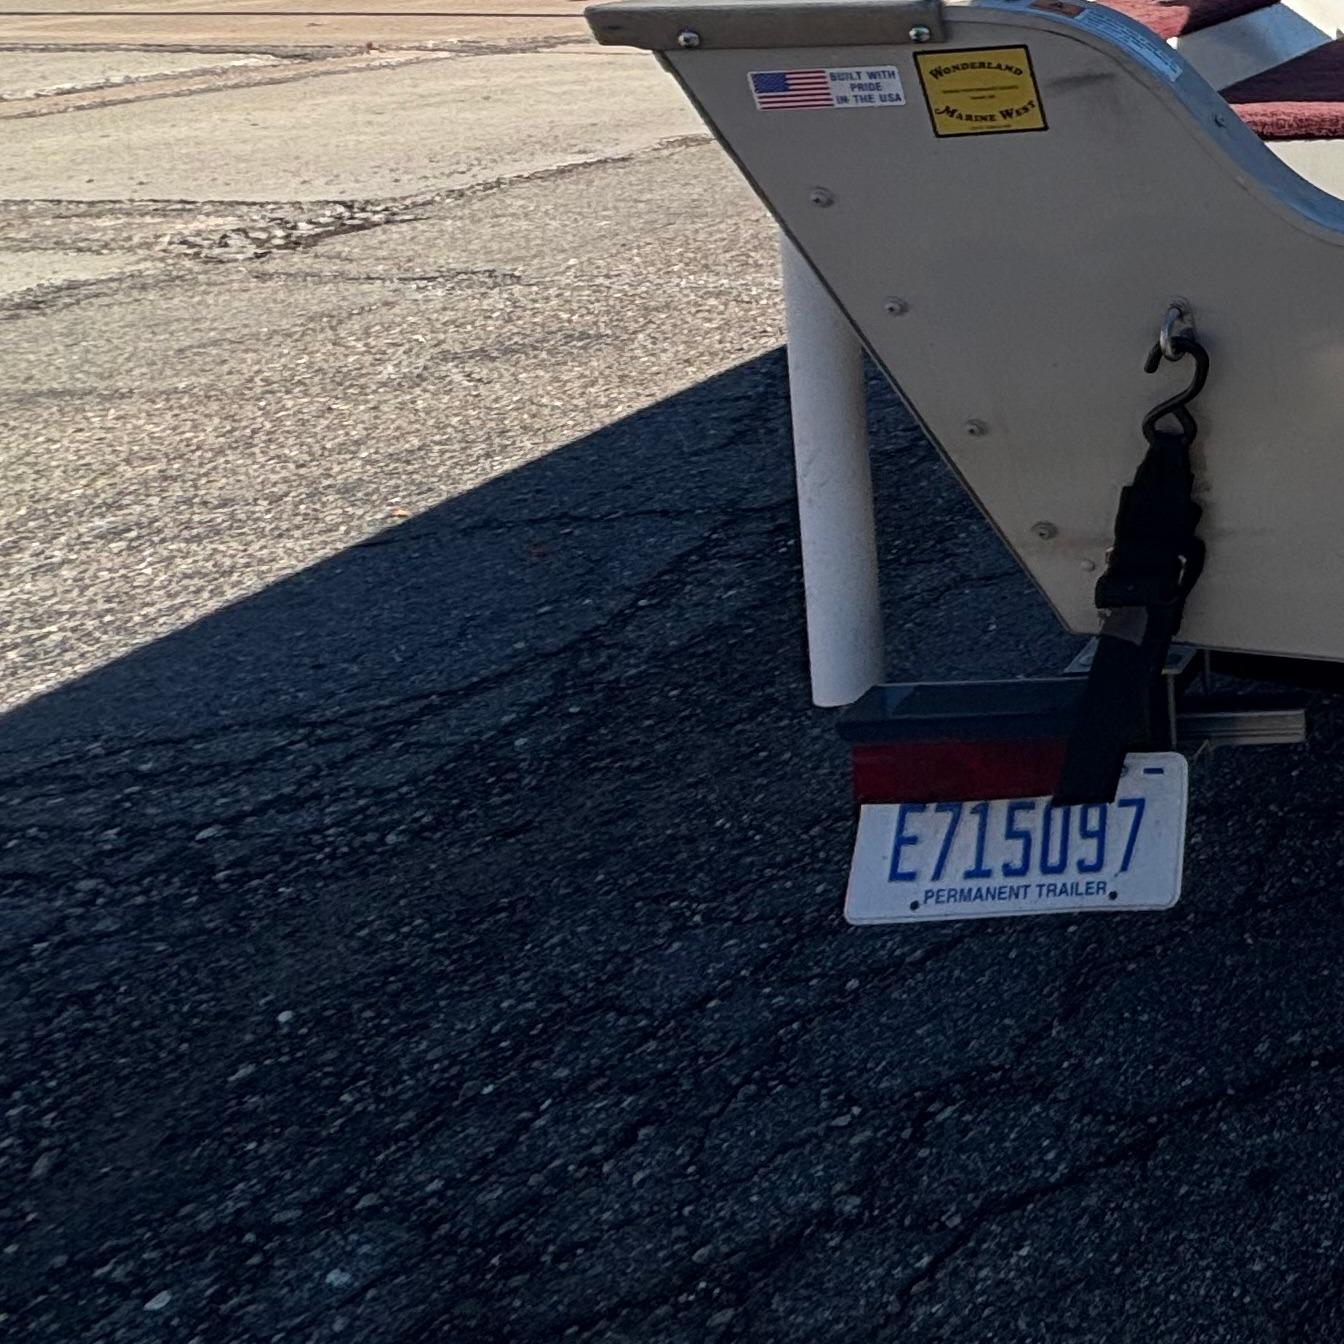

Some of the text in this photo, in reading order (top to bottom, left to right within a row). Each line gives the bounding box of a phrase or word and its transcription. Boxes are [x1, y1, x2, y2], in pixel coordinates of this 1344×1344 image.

[829, 70, 896, 82] BUILT WITH
[928, 61, 1024, 80] WONDERLAND
[850, 82, 883, 92] PRIDE
[835, 93, 902, 104] IN THE USA
[935, 100, 1037, 123] MARINE WEST
[887, 797, 1147, 882] E715097
[923, 881, 1108, 906] PERMANENT TRAILER
